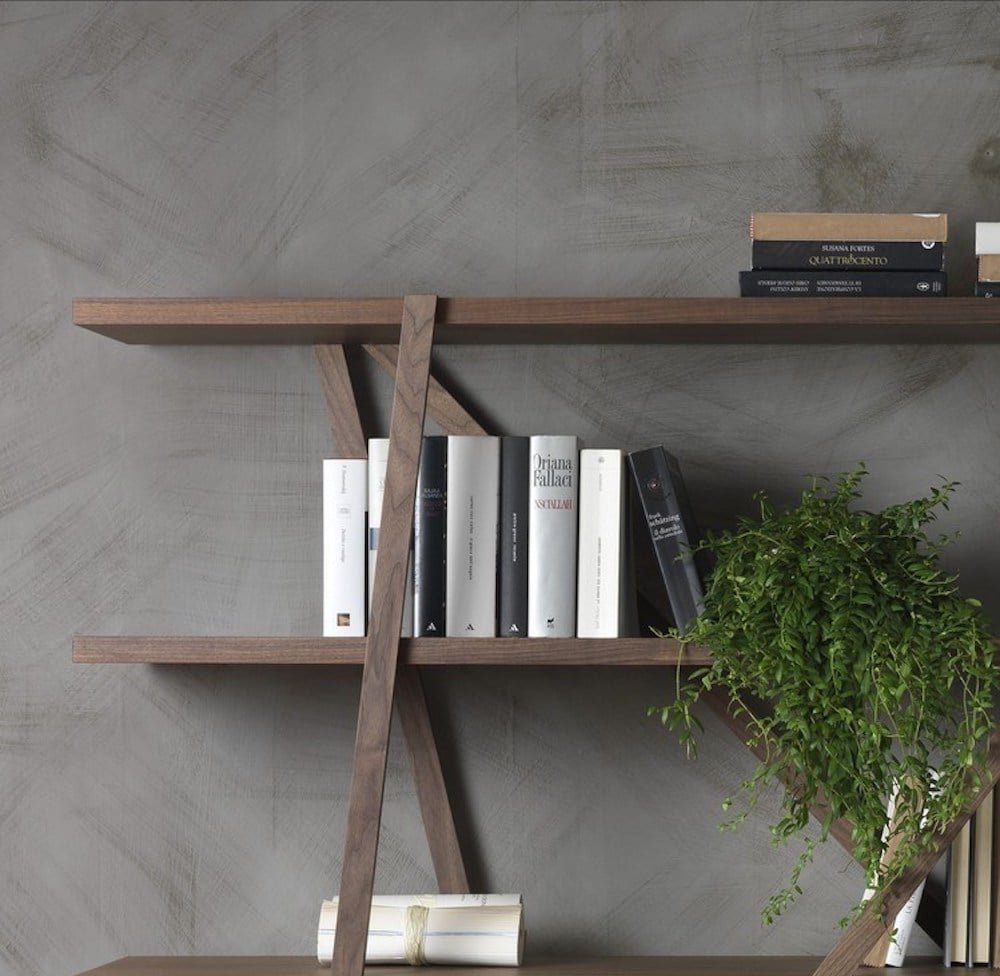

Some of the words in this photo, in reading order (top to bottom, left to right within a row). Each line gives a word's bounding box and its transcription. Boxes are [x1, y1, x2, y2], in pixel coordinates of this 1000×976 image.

[821, 244, 849, 253] SUSANA
[850, 244, 876, 253] FORTES
[808, 252, 889, 267] QUATTROCENTO
[533, 454, 573, 471] Oriana
[533, 470, 572, 487] Fallaci
